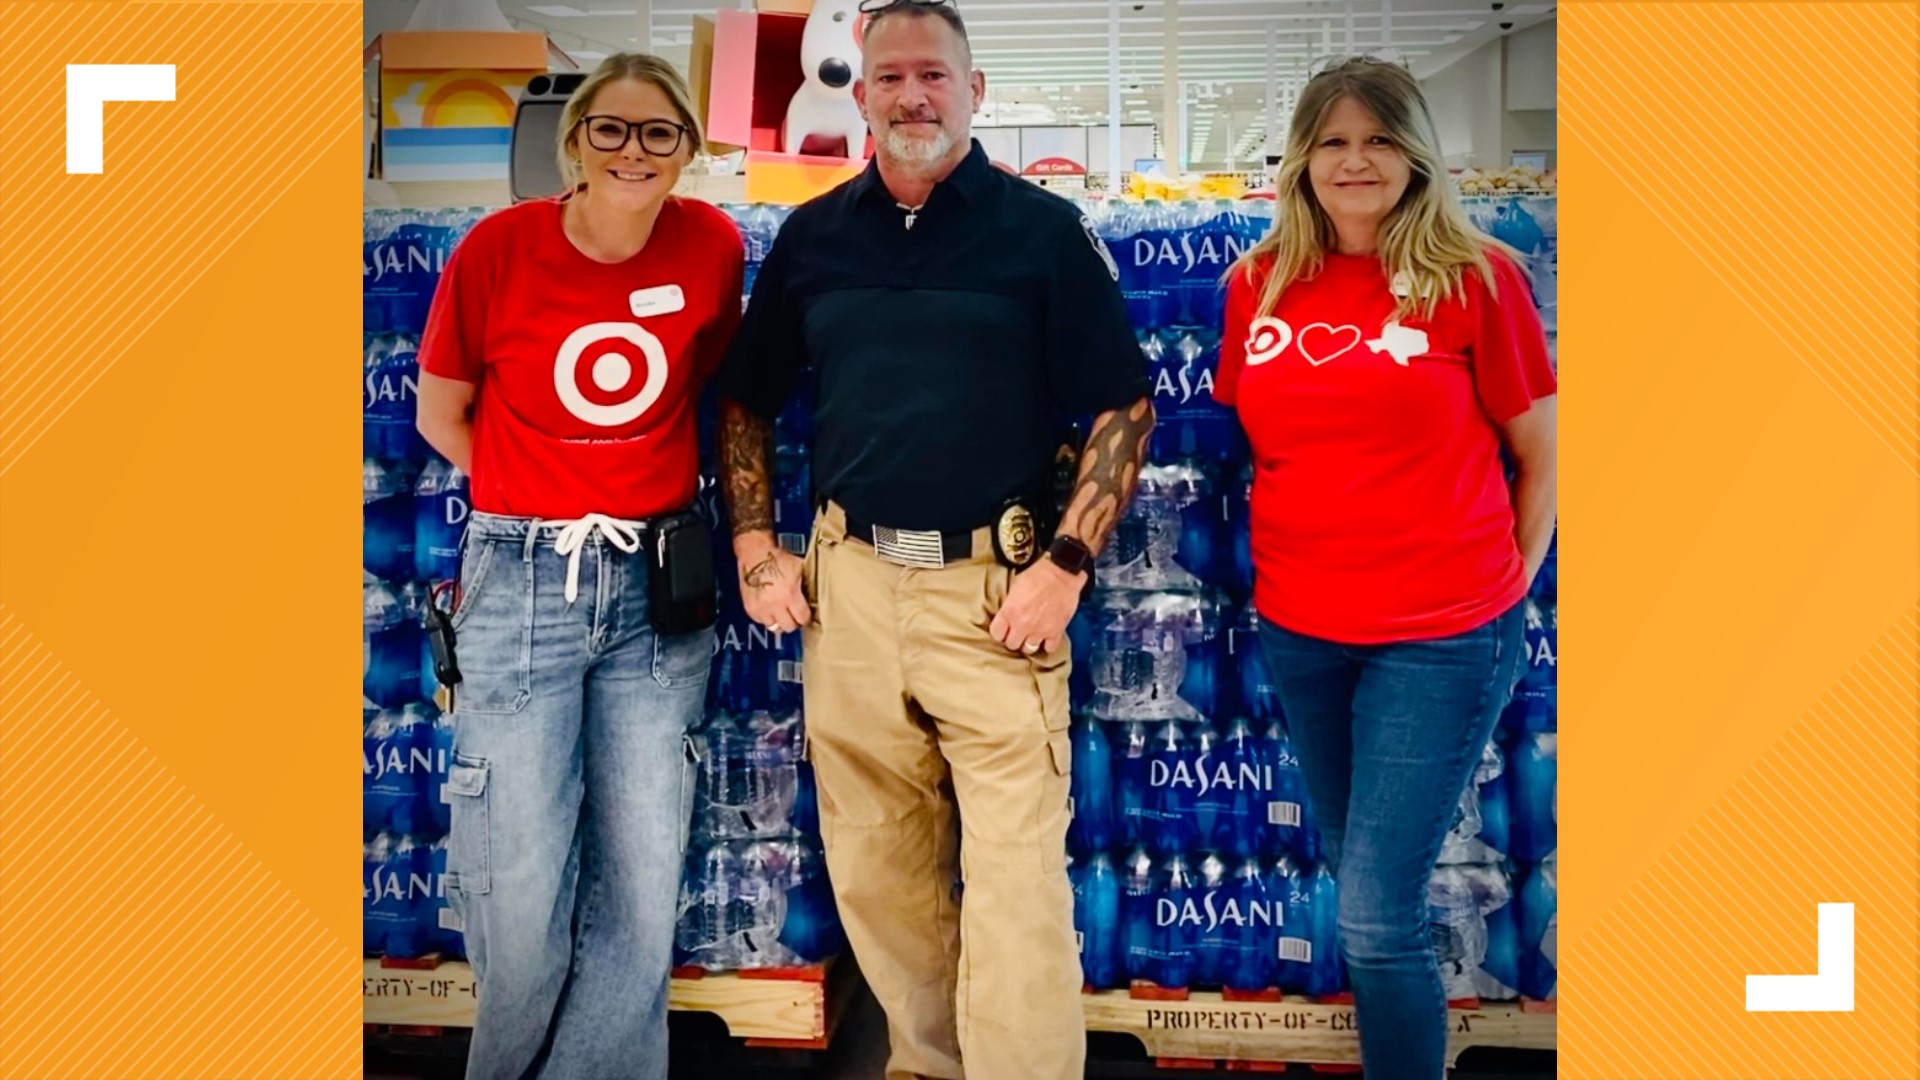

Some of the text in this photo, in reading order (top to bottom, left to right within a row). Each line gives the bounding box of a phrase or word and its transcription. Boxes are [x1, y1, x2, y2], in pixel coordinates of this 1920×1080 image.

[363, 368, 418, 408] SAN
[1149, 362, 1215, 405] ASA
[1150, 752, 1298, 797] DASANI 24
[1157, 890, 1310, 933] DASANI 24
